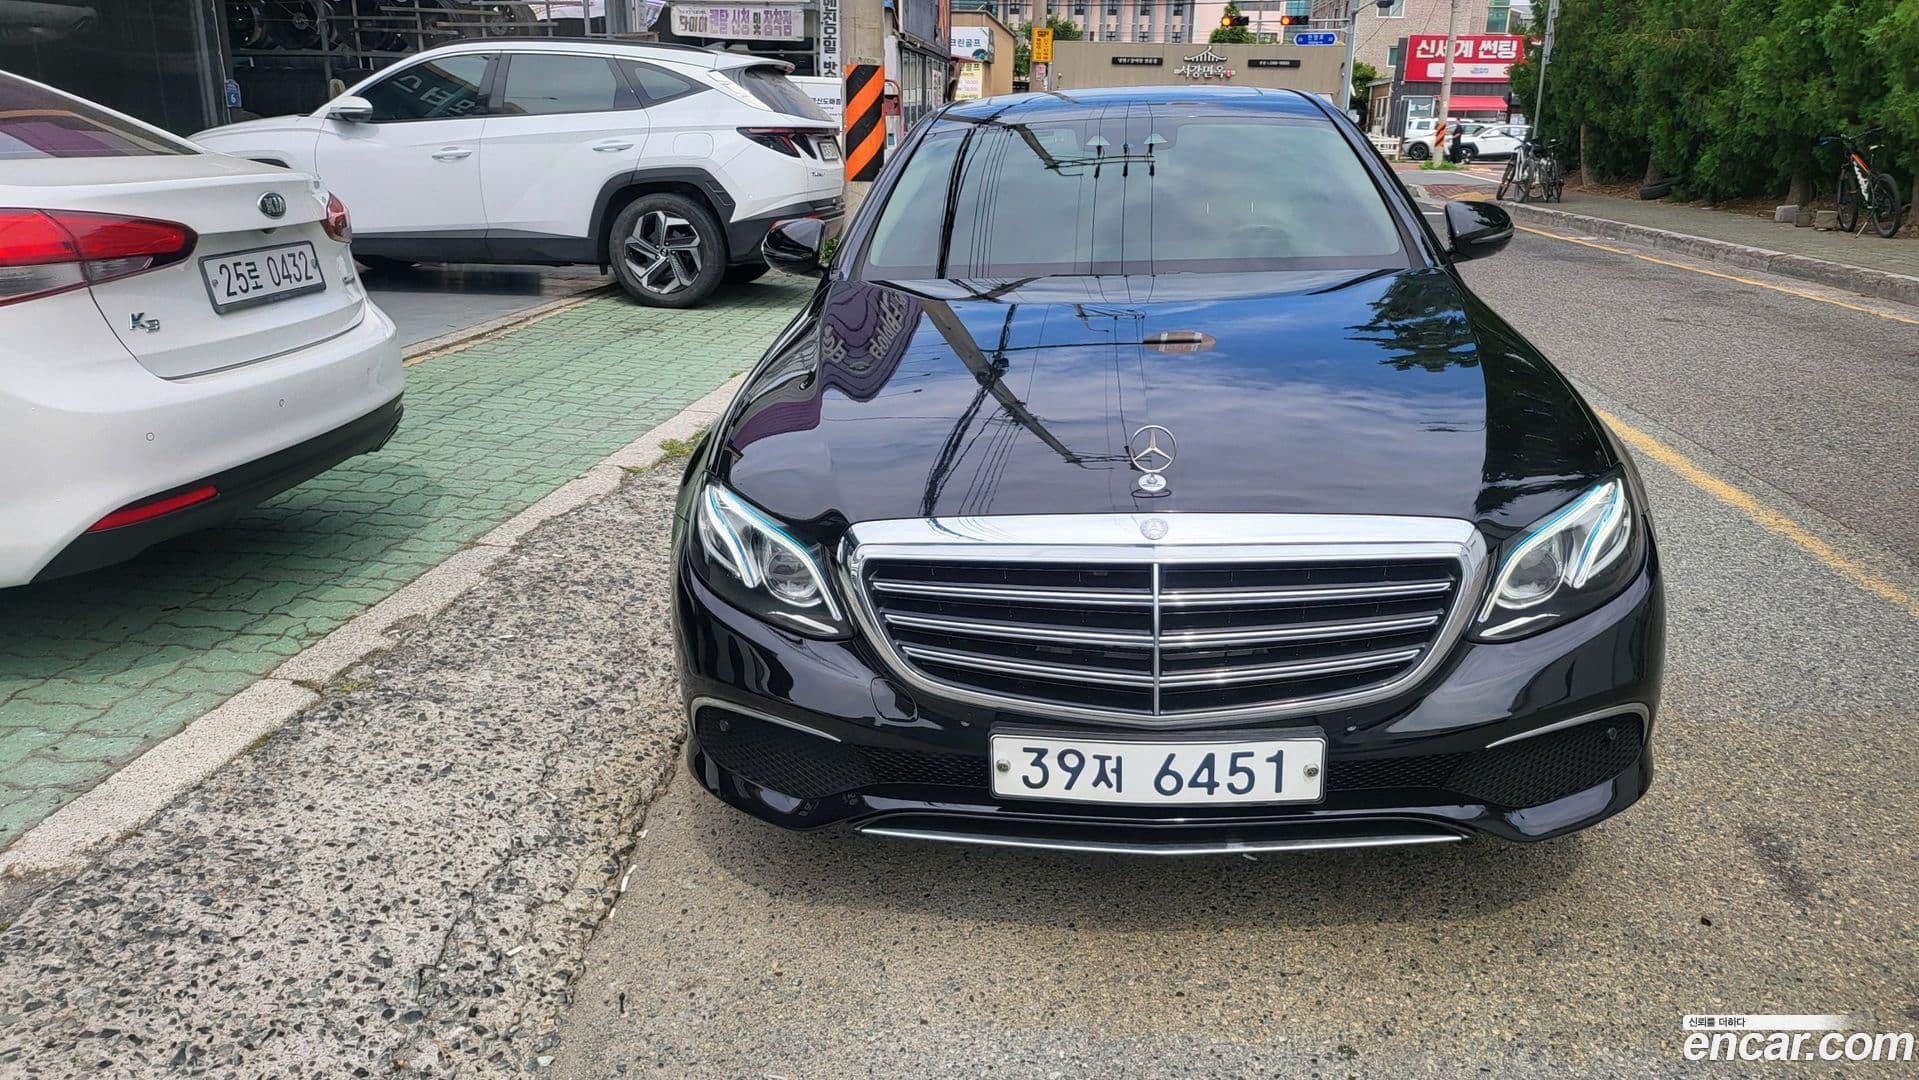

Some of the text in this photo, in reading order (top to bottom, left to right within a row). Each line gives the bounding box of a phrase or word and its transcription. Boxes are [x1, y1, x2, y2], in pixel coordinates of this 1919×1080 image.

[709, 9, 729, 35] 렌탈
[732, 8, 750, 36] 신청
[753, 12, 761, 35] 및
[763, 8, 792, 37] 장착점
[1415, 39, 1517, 60] 신세계 썬팅
[1175, 63, 1226, 79] 서강면옥
[218, 250, 313, 297] 25로 0432
[129, 312, 160, 333] K3
[1021, 746, 1285, 797] 39저 6451
